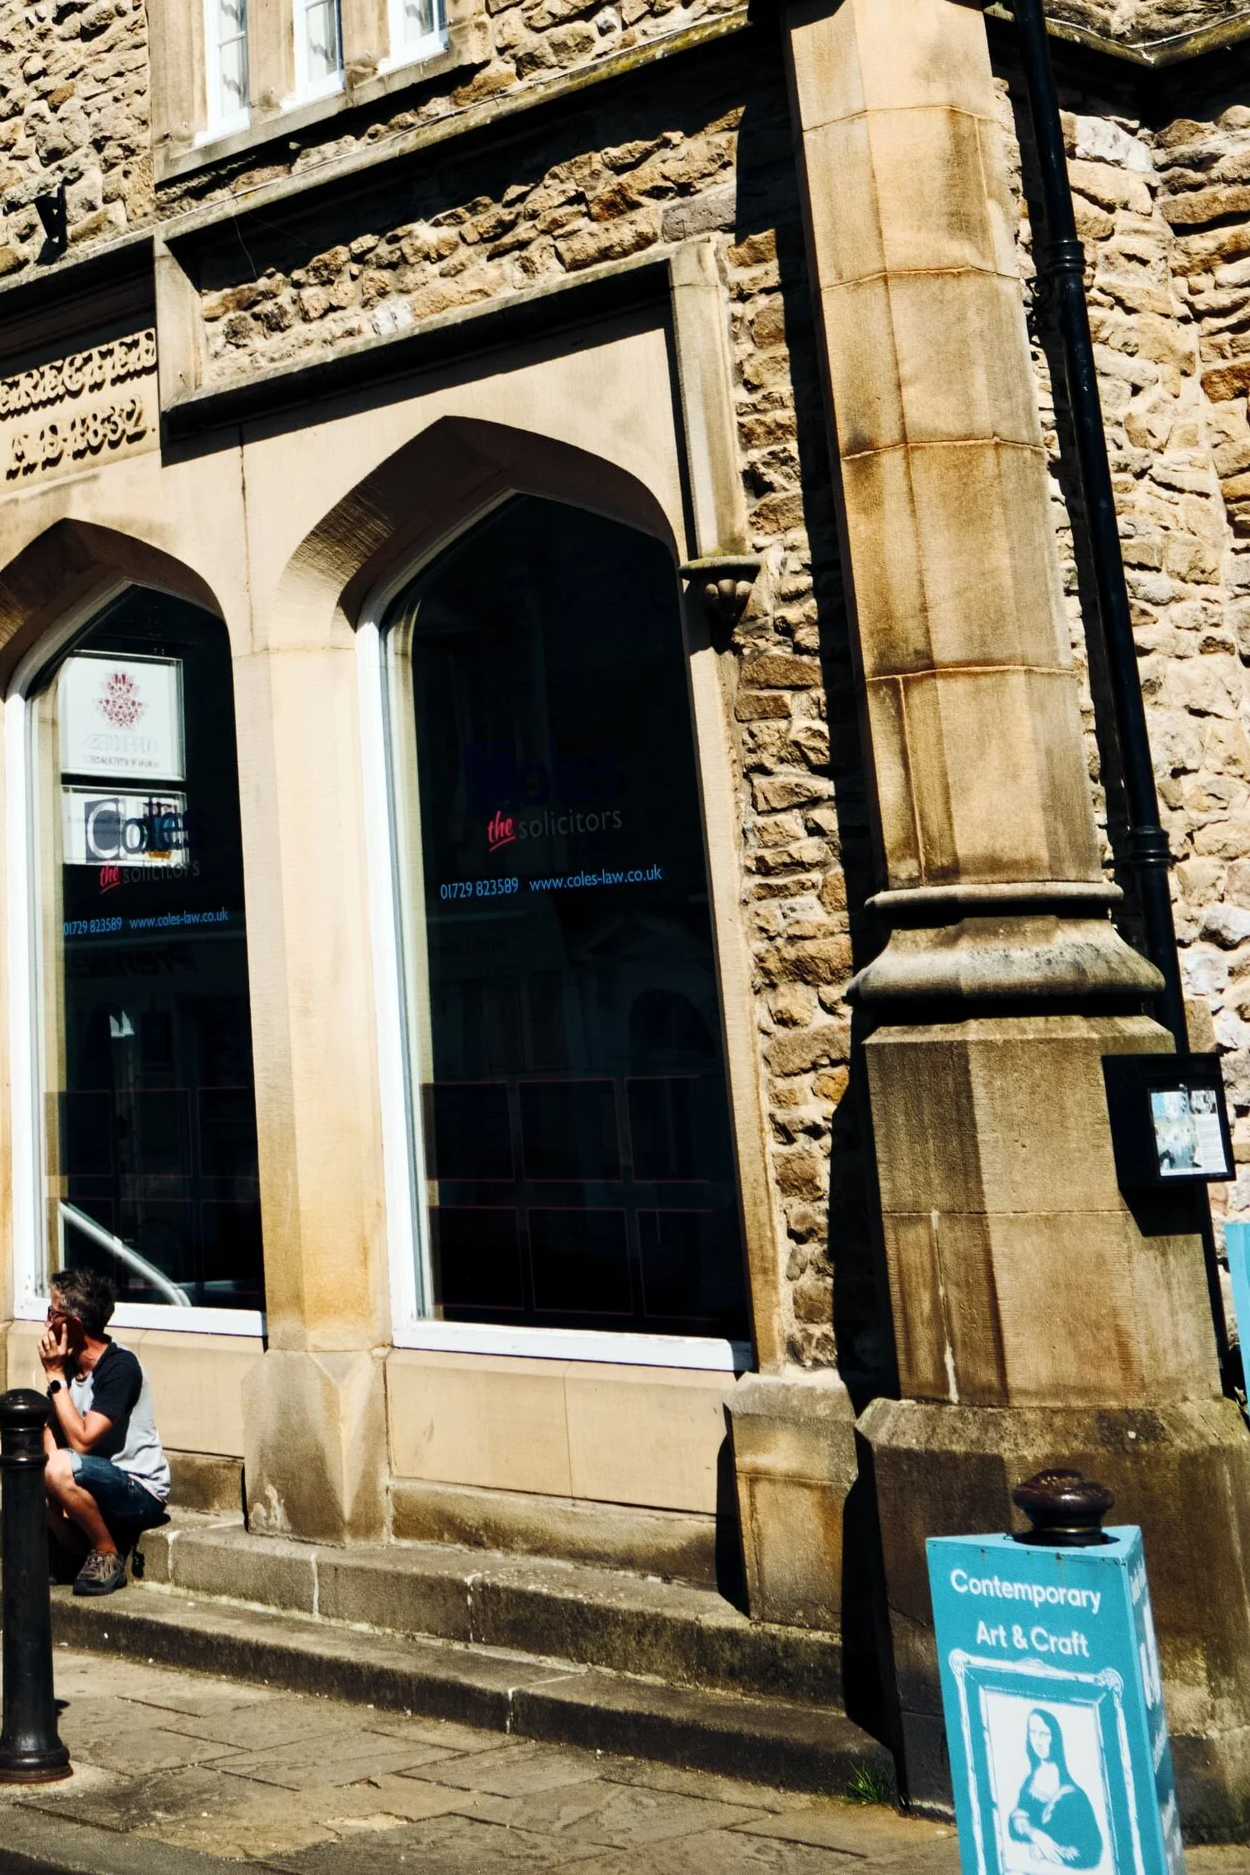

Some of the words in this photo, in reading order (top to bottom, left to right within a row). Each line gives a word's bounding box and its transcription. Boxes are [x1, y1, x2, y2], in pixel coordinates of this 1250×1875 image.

[487, 810, 515, 850] the
[519, 808, 623, 841] solicitors
[99, 859, 121, 893] the
[123, 860, 200, 885] solicitors
[440, 881, 473, 900] 01729
[475, 877, 520, 897] 823589
[529, 864, 662, 892] www.coles-law.co.uk
[63, 920, 88, 936] 01729
[89, 917, 123, 934] 823589
[129, 906, 229, 929] www.coles-law.co.uk
[950, 1568, 1101, 1615] Contemporary
[976, 1620, 1008, 1648] Art
[1012, 1624, 1029, 1649] &
[1030, 1626, 1090, 1658] Craft
